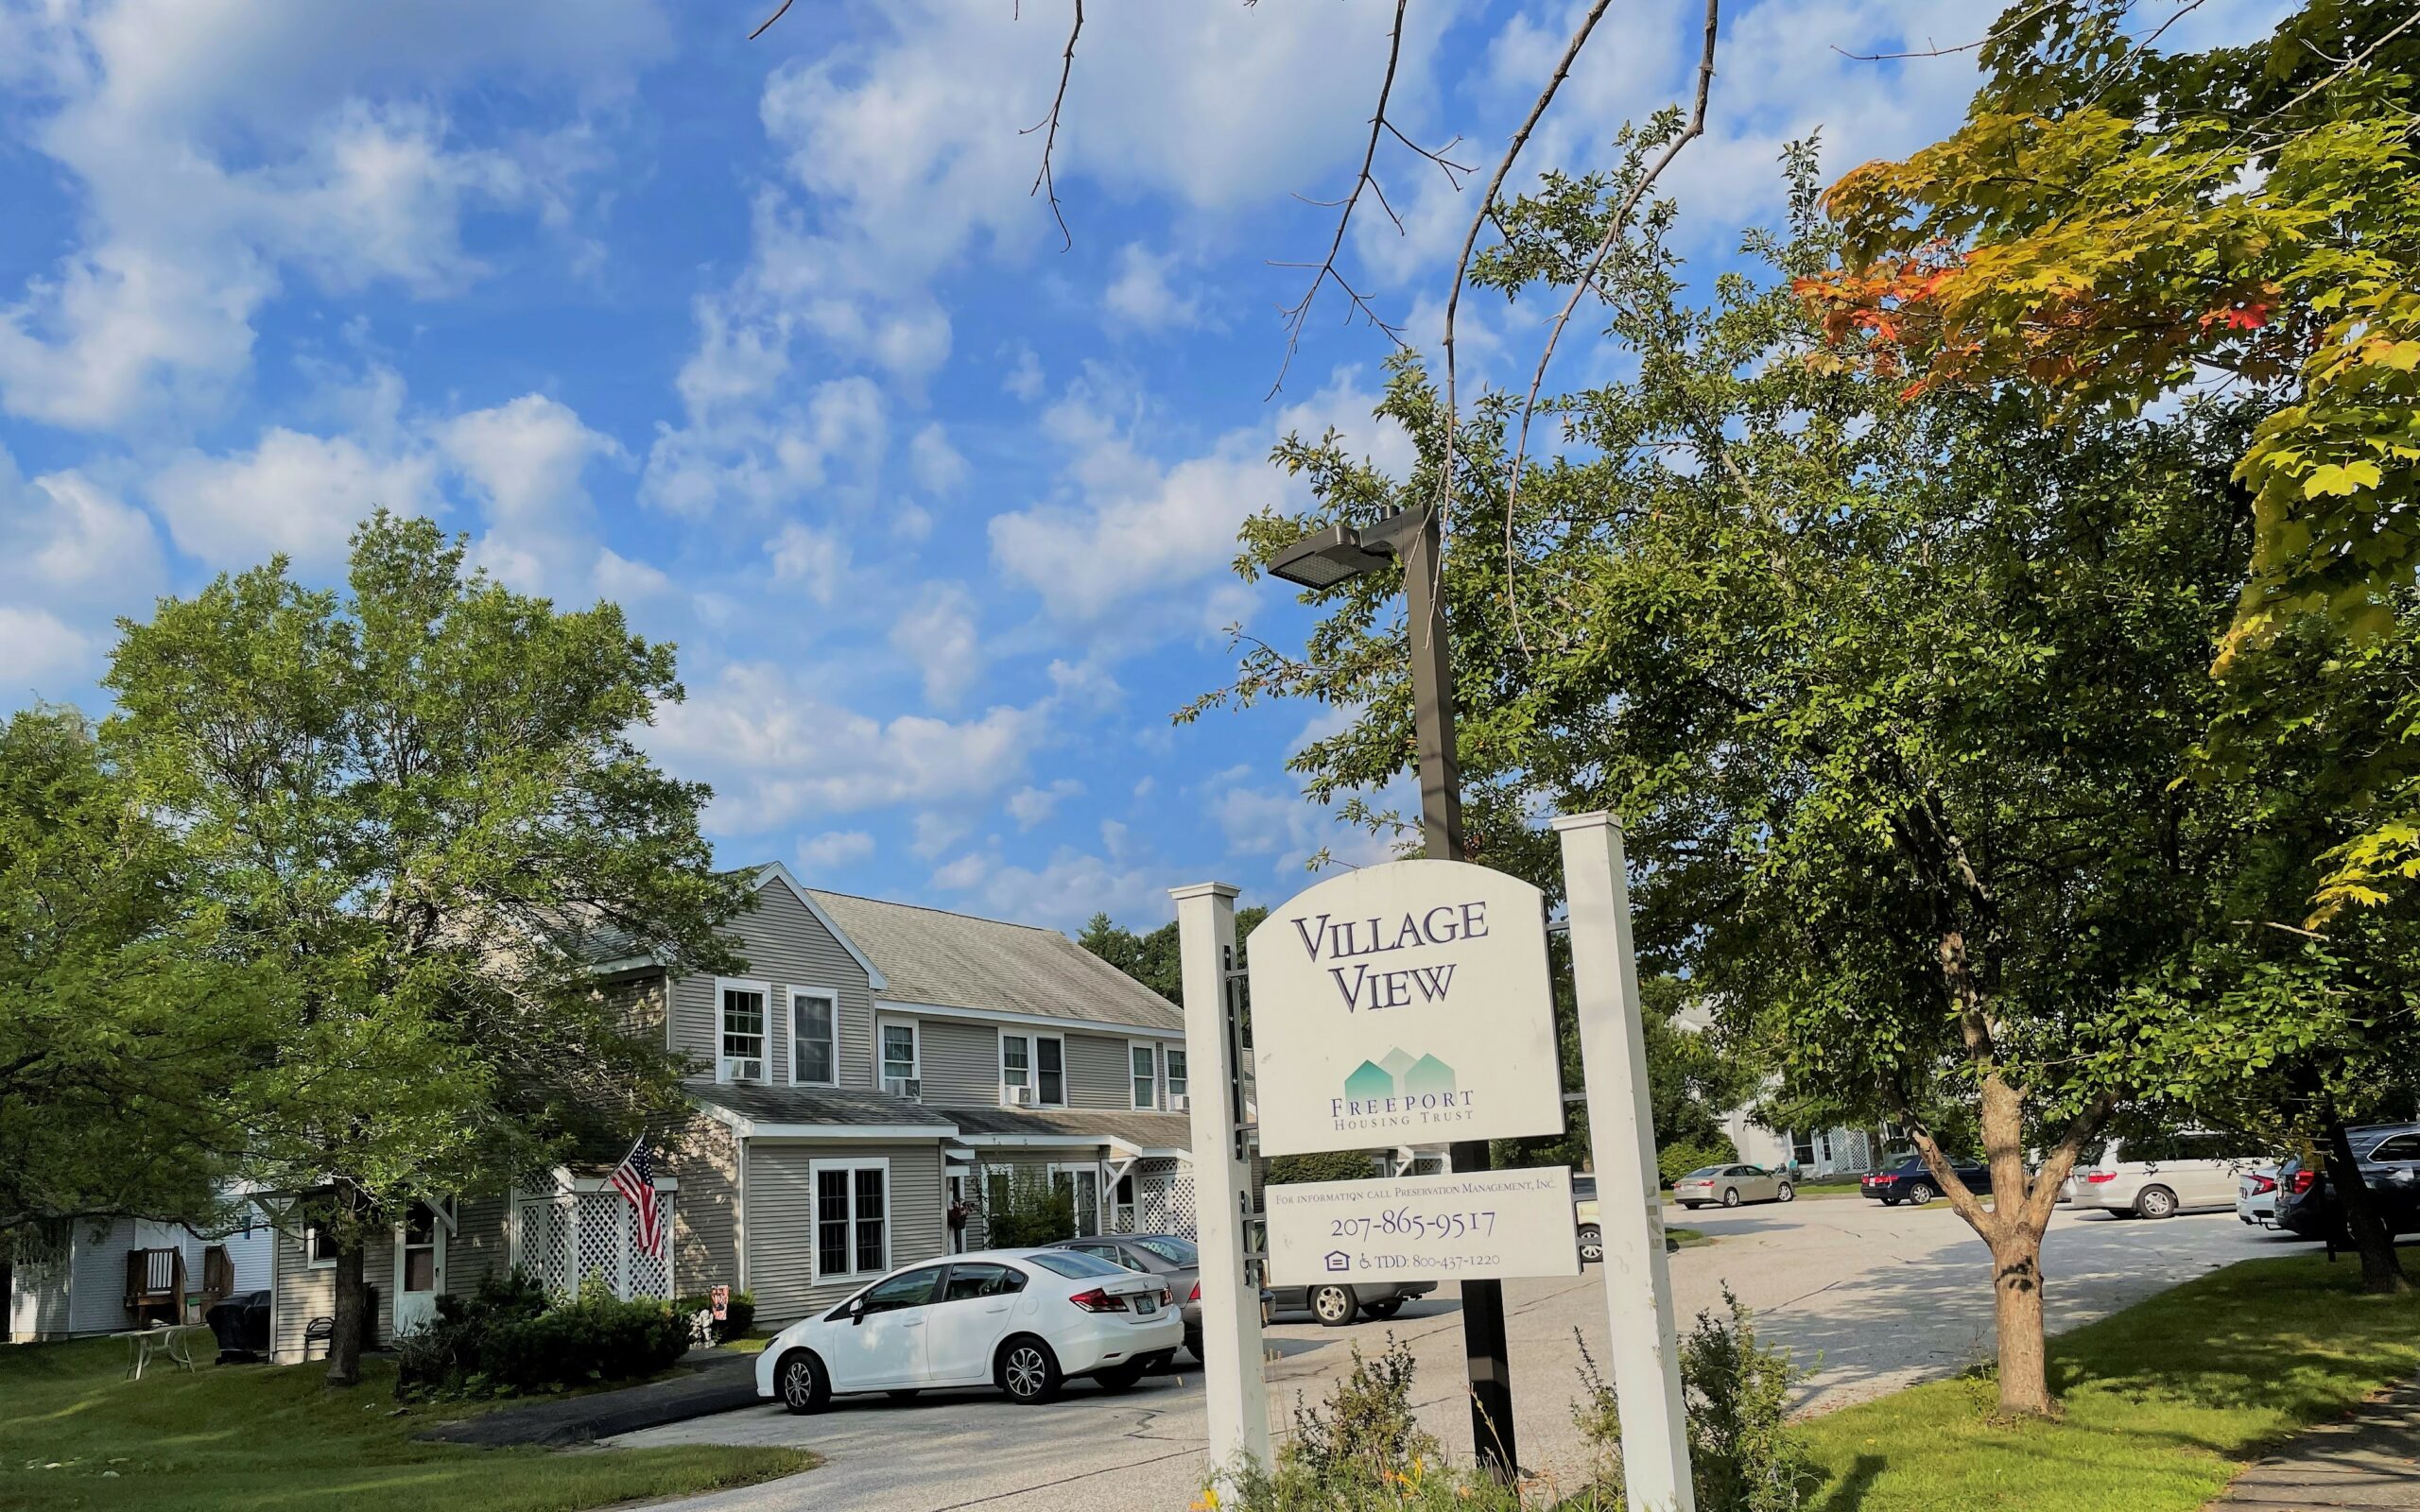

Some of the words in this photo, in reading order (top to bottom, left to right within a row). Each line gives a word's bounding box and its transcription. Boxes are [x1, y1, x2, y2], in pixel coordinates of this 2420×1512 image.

[1290, 902, 1489, 963] VILLAGE
[1327, 963, 1457, 1013] VIEW
[1331, 1091, 1474, 1117] FREEPORT
[1335, 1116, 1409, 1131] HOUSING
[1421, 1109, 1473, 1124] TRUST
[1276, 1194, 1294, 1205] FOR
[1367, 1190, 1392, 1199] CALL
[1331, 1206, 1495, 1243] 207-865-9517
[1374, 1255, 1409, 1268] TDD:
[1412, 1255, 1500, 1270] 800-437-1220
